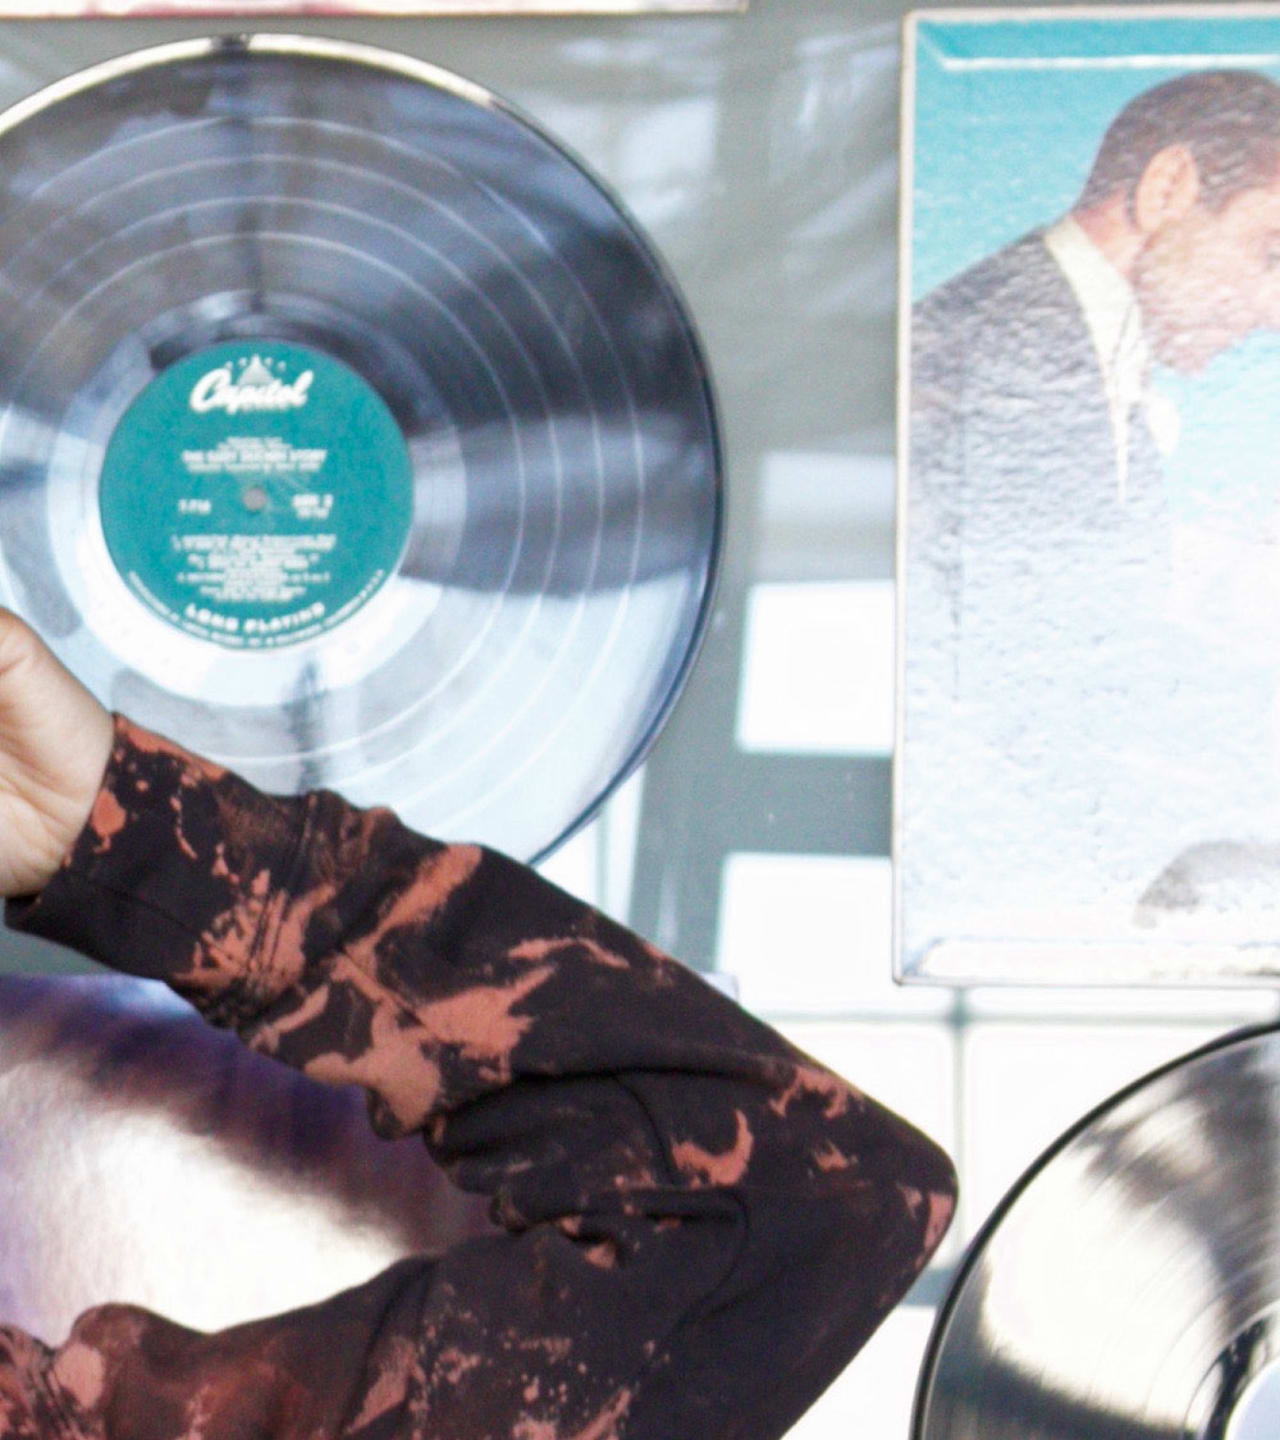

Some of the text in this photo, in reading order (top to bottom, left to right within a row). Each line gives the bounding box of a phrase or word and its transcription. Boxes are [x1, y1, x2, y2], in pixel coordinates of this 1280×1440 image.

[190, 368, 314, 415] Capitol
[185, 601, 326, 634] LONG PLAYING
